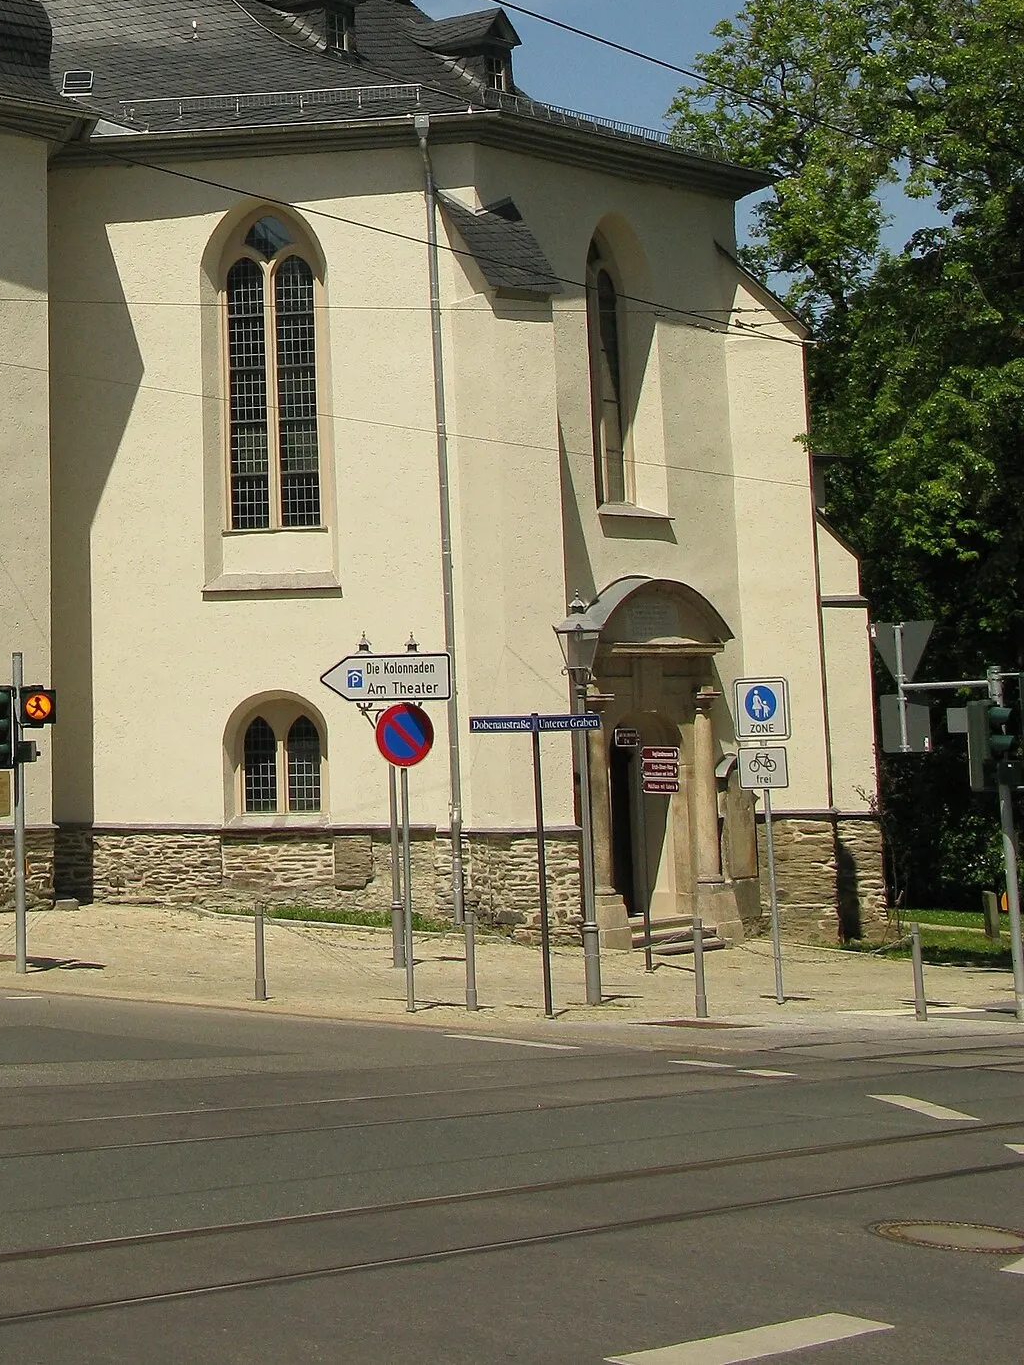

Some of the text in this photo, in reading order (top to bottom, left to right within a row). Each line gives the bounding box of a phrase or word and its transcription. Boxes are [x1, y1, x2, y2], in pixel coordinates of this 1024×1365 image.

[366, 661, 435, 674] Die Kolonnaden
[367, 681, 438, 694] Am Theater
[472, 720, 531, 730] Dobenaustraße
[538, 717, 598, 729] Unterer Graben
[750, 723, 775, 734] ZONE
[756, 774, 772, 784] frei
